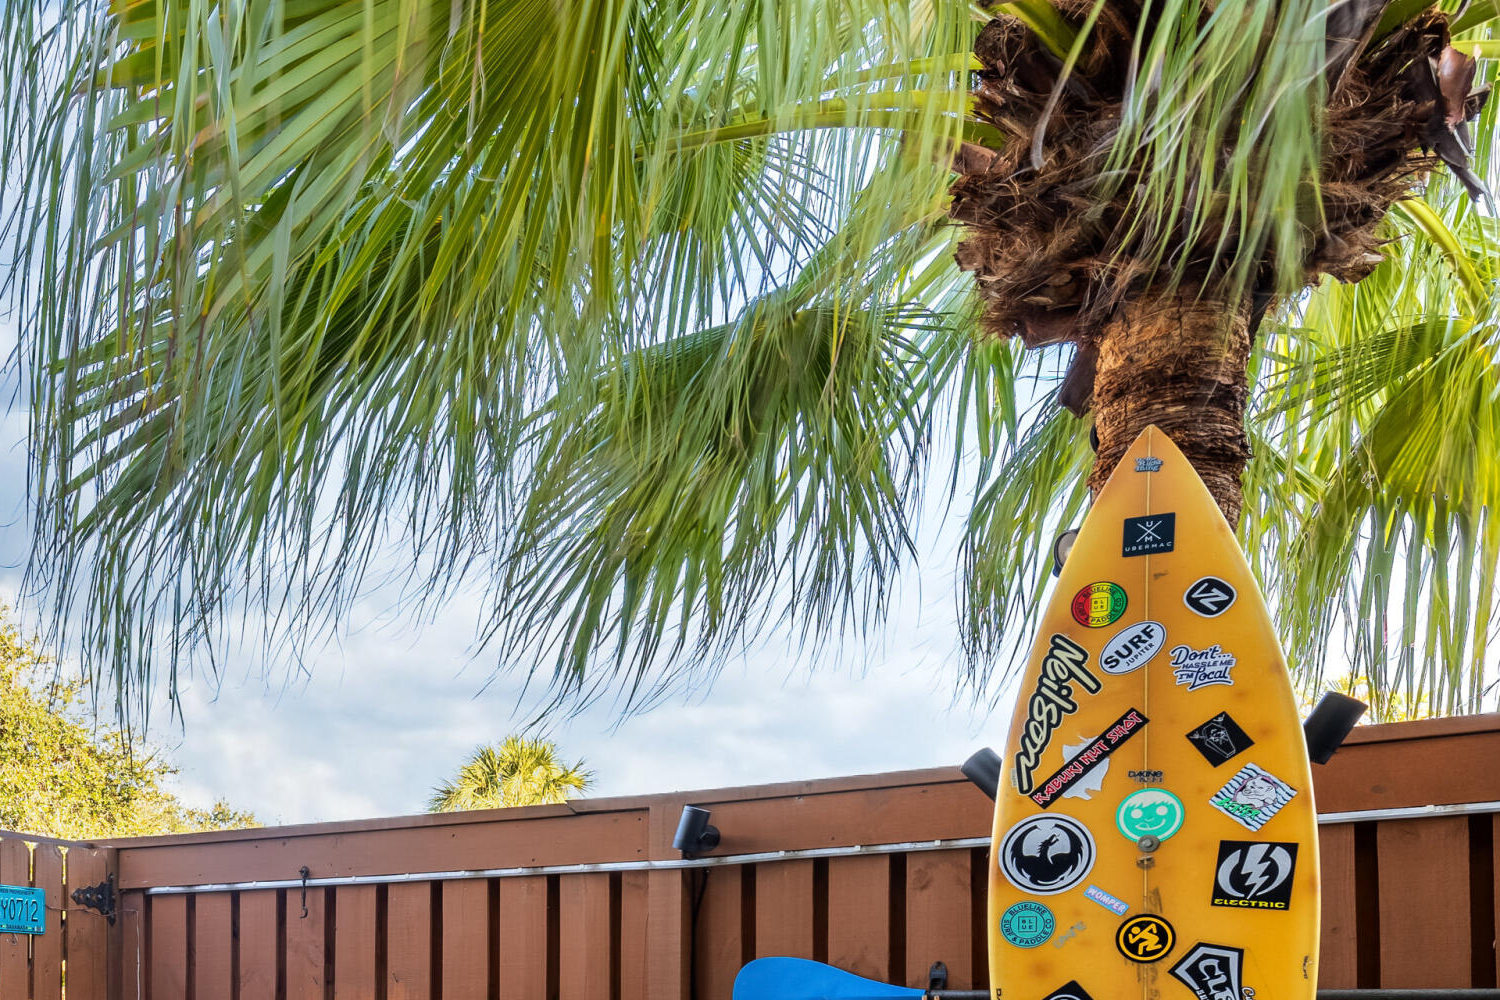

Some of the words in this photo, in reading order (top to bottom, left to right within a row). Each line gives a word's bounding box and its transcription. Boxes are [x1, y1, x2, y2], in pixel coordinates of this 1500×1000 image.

[1124, 541, 1173, 552] UBERMAC
[1104, 624, 1155, 669] SURF
[1125, 642, 1155, 667] JUPITER
[1182, 660, 1219, 670] HASSLE
[1219, 659, 1235, 667] ME
[1188, 666, 1230, 690] Local
[1018, 635, 1100, 794] Neilson
[1032, 760, 1085, 805] KABUKI
[1078, 739, 1110, 766] NUT
[1105, 711, 1144, 745] SHOT
[1008, 903, 1047, 916] BLUELINE
[1087, 887, 1127, 913] WOMPER
[1213, 898, 1286, 909] ELECTRIC
[1003, 919, 1016, 936] SURF
[1018, 929, 1049, 945] PADDLE
[1045, 918, 1052, 929] CO
